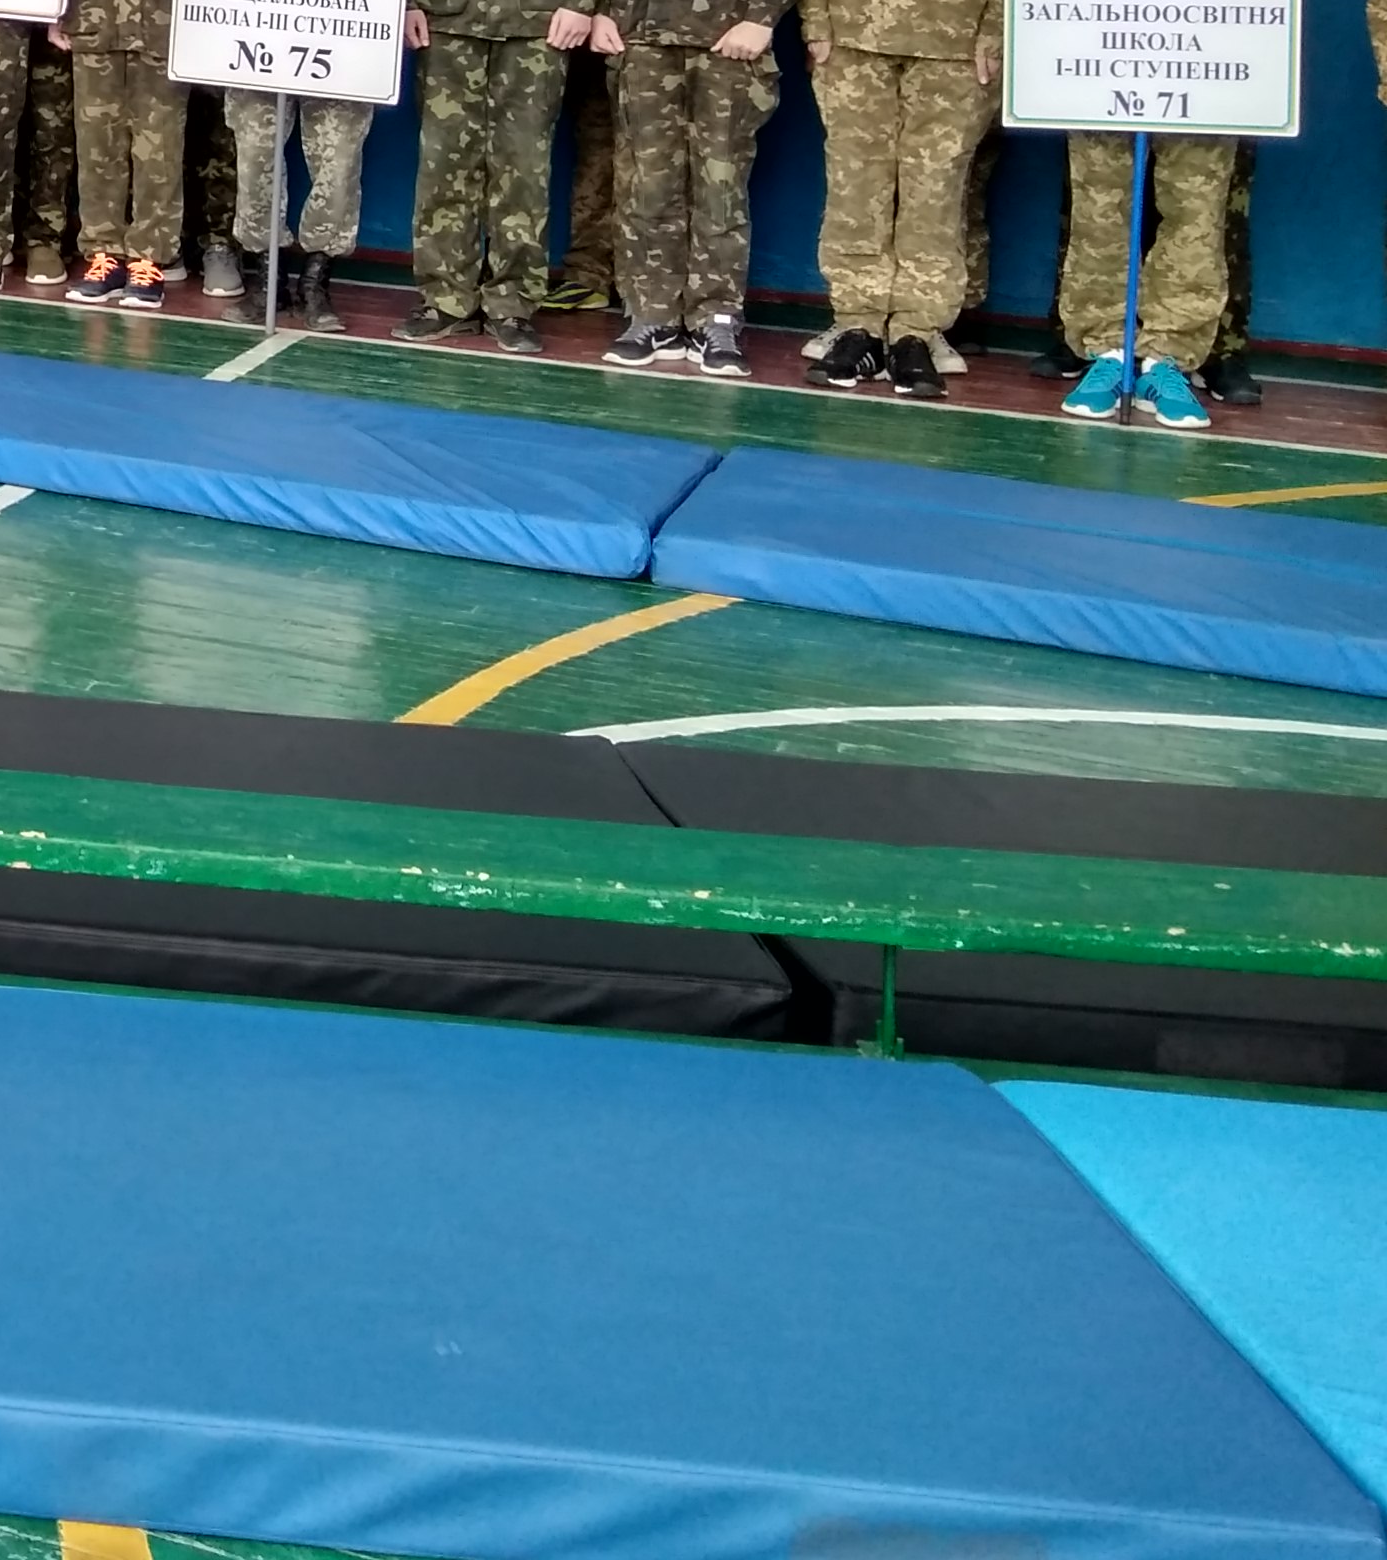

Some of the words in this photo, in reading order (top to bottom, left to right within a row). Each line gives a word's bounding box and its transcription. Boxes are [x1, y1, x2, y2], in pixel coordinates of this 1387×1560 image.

[183, 4, 251, 28] ШКОЛА
[293, 15, 391, 41] СТУПЕНІВ
[1022, 2, 1286, 25] ЗАГАЛЬНООСВІТНЯ
[1101, 31, 1202, 52] ШКОЛА
[229, 39, 274, 73] №
[288, 45, 333, 79] 75
[1109, 60, 1250, 81] СТУПЕНІВ
[1107, 90, 1145, 117] №
[1156, 91, 1192, 119] 71
